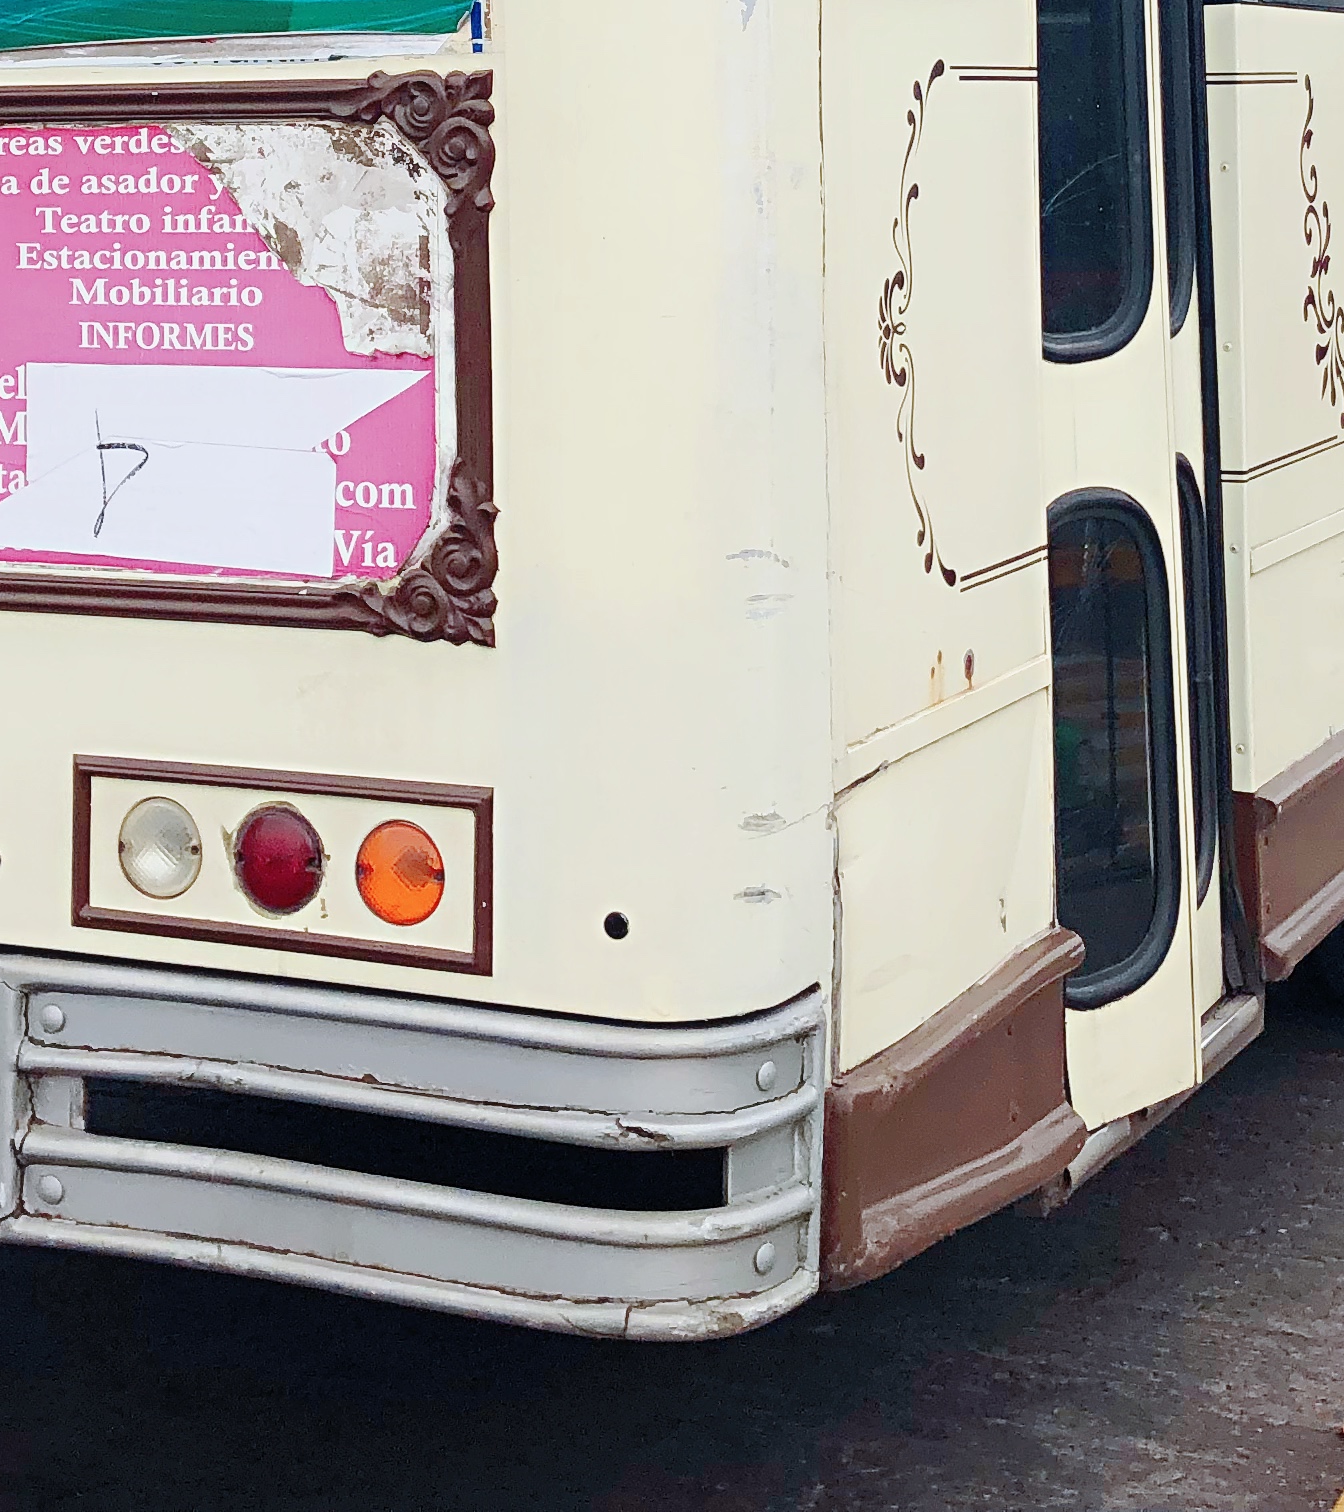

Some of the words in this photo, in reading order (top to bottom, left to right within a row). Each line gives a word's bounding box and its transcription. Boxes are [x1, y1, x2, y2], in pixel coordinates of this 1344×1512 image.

[73, 127, 186, 156] verdes
[31, 168, 70, 195] de
[81, 167, 200, 195] asador
[35, 206, 151, 234] Teatro
[161, 205, 255, 234] infan
[16, 242, 289, 271] Estacionamien
[68, 278, 263, 307] Mobiliario
[78, 321, 255, 352] INFORMES
[336, 480, 417, 510] com
[334, 529, 398, 568] Vía
